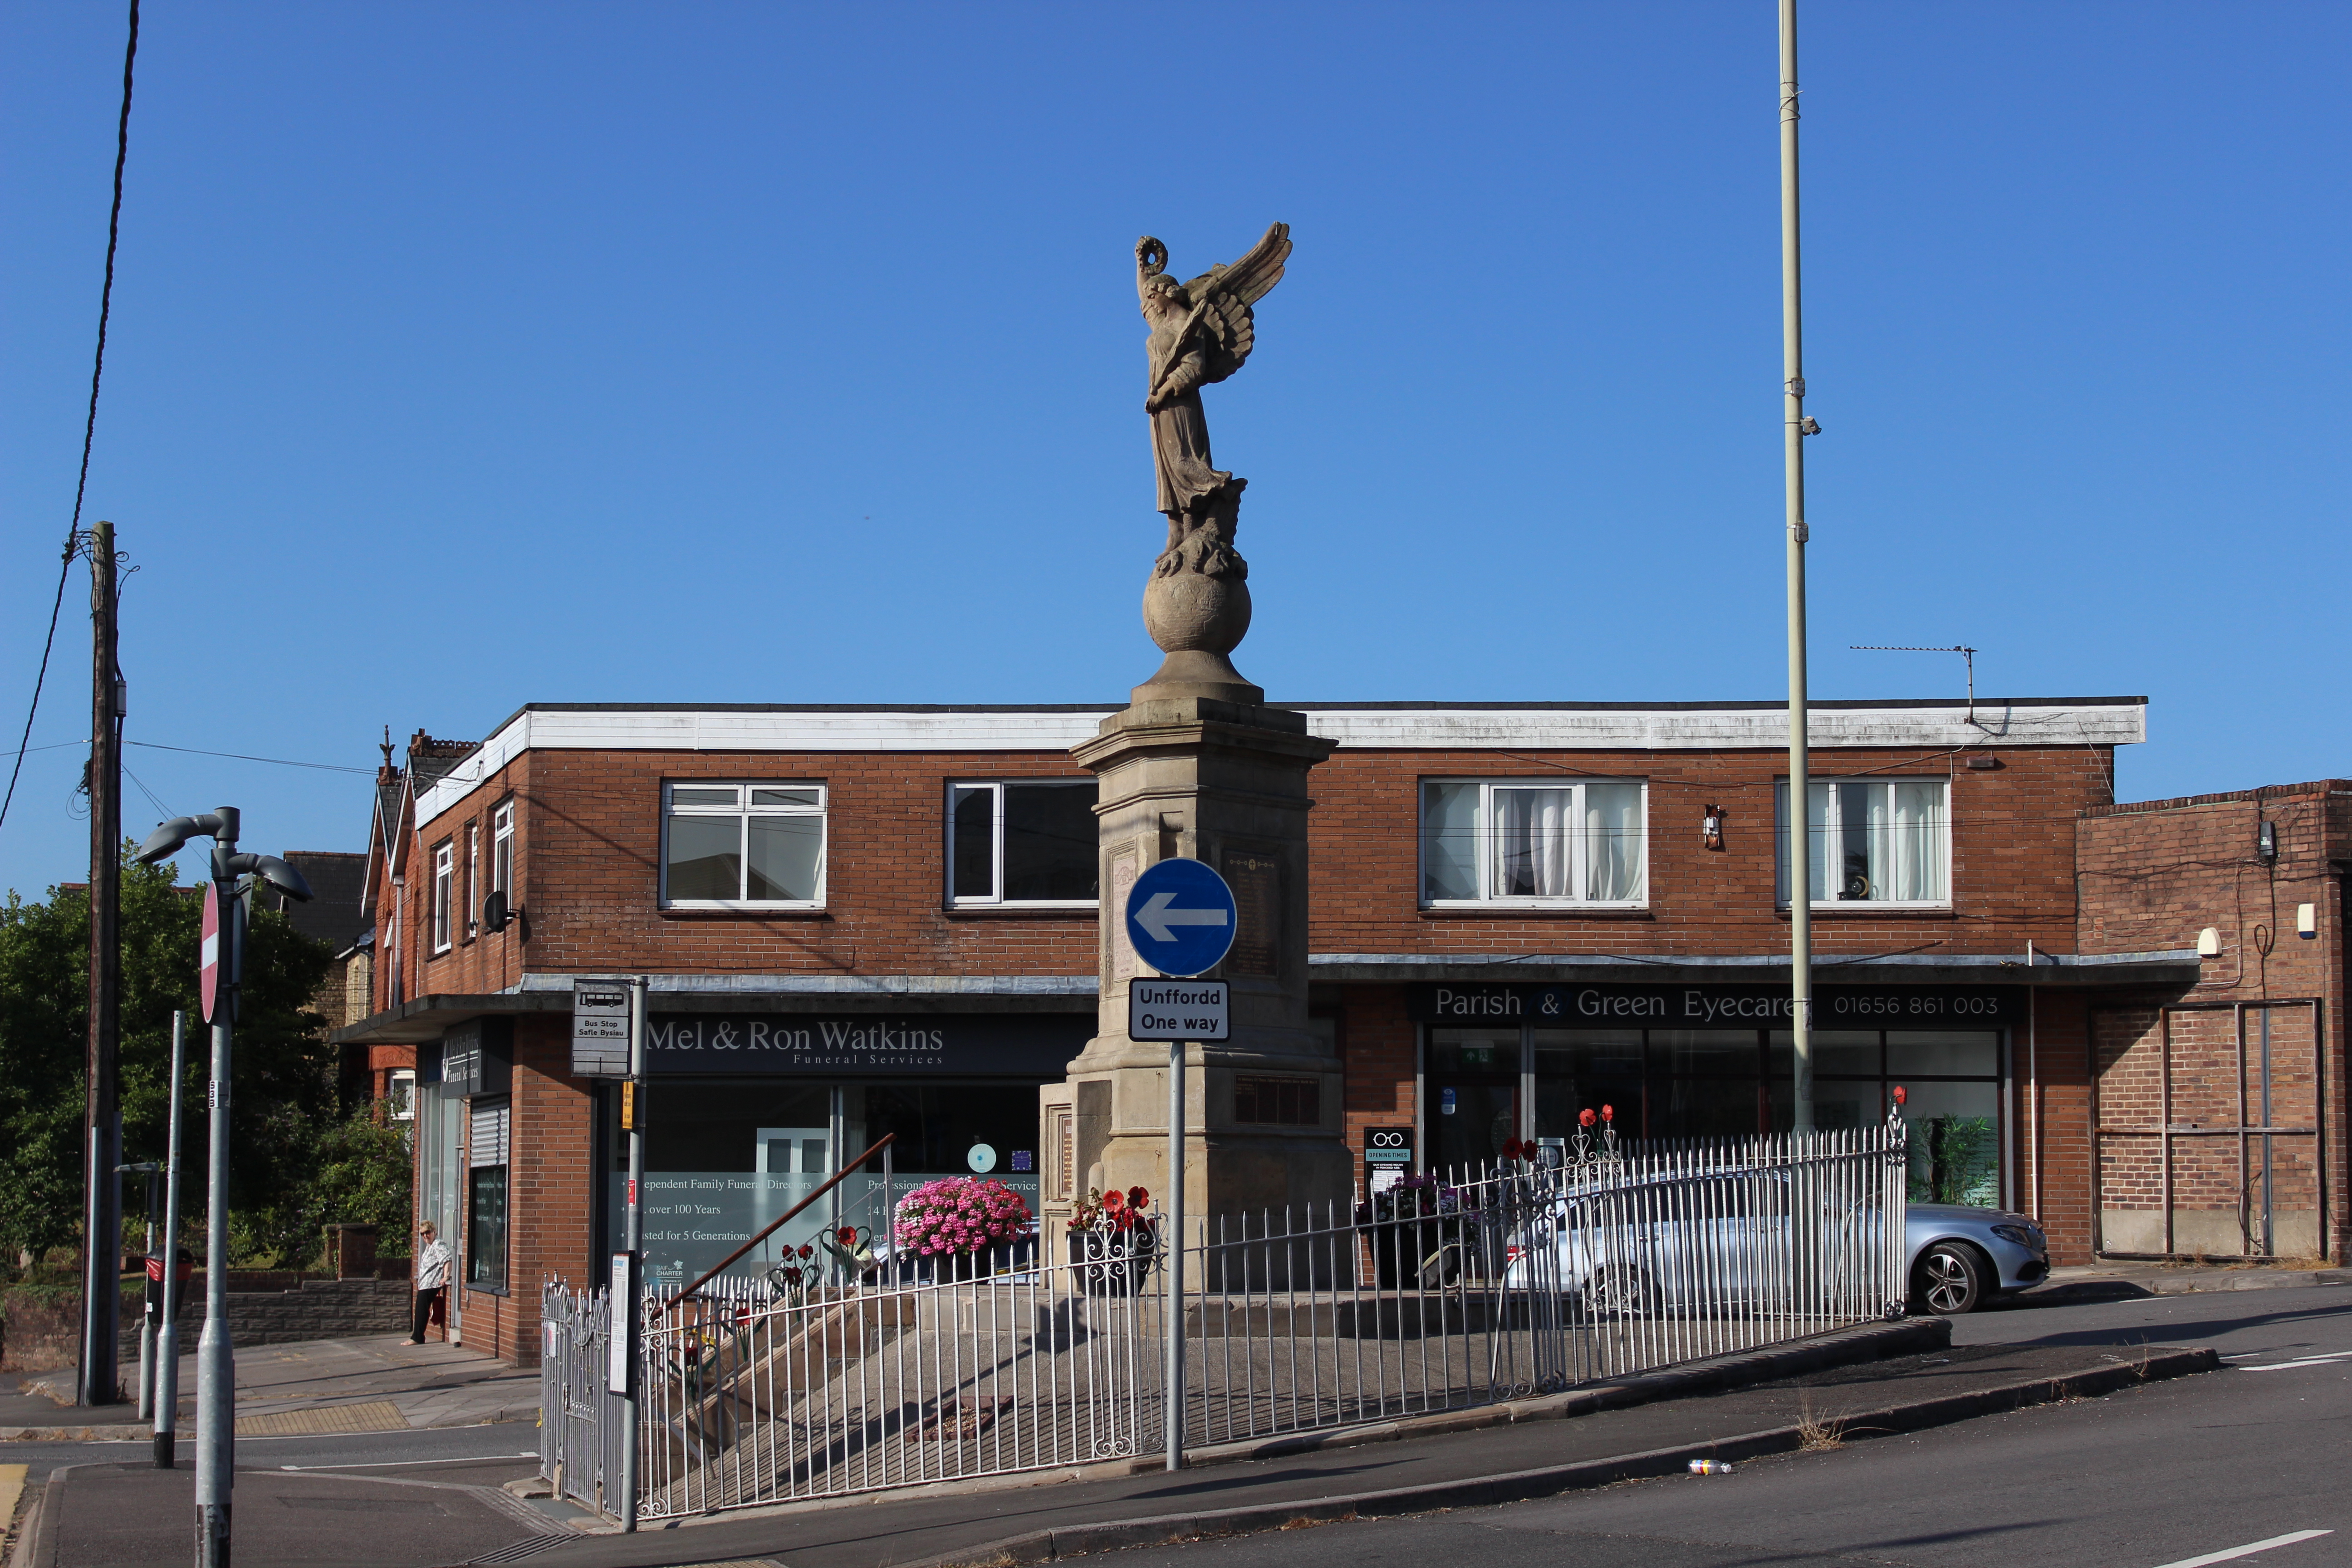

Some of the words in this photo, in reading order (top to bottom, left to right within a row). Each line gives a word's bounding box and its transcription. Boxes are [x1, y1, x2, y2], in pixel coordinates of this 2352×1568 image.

[1140, 989, 1220, 1004] Unffordd
[1436, 989, 1521, 1014] Parish
[1542, 994, 1559, 1014] &
[1578, 990, 1666, 1015] Green
[1835, 998, 1900, 1013] 01656
[1910, 998, 1944, 1013] 861
[1955, 998, 1997, 1014] 003
[1142, 1014, 1177, 1029] One
[1184, 1018, 1219, 1033] way
[646, 1021, 704, 1049] Mel
[712, 1022, 740, 1050] &
[747, 1022, 812, 1050] Ron
[817, 1022, 943, 1050] Watkins
[794, 1054, 857, 1064] Funeral
[870, 1054, 942, 1064] Services
[449, 1068, 462, 1083] Funeral
[644, 1180, 687, 1191] ependent
[691, 1179, 724, 1191] Family
[727, 1179, 763, 1189] Funeral
[767, 1179, 812, 1190] Directors
[675, 1204, 691, 1214] 100
[695, 1205, 721, 1214] Years
[666, 1230, 681, 1240] for
[683, 1230, 689, 1240] 5
[692, 1230, 750, 1240] Generations
